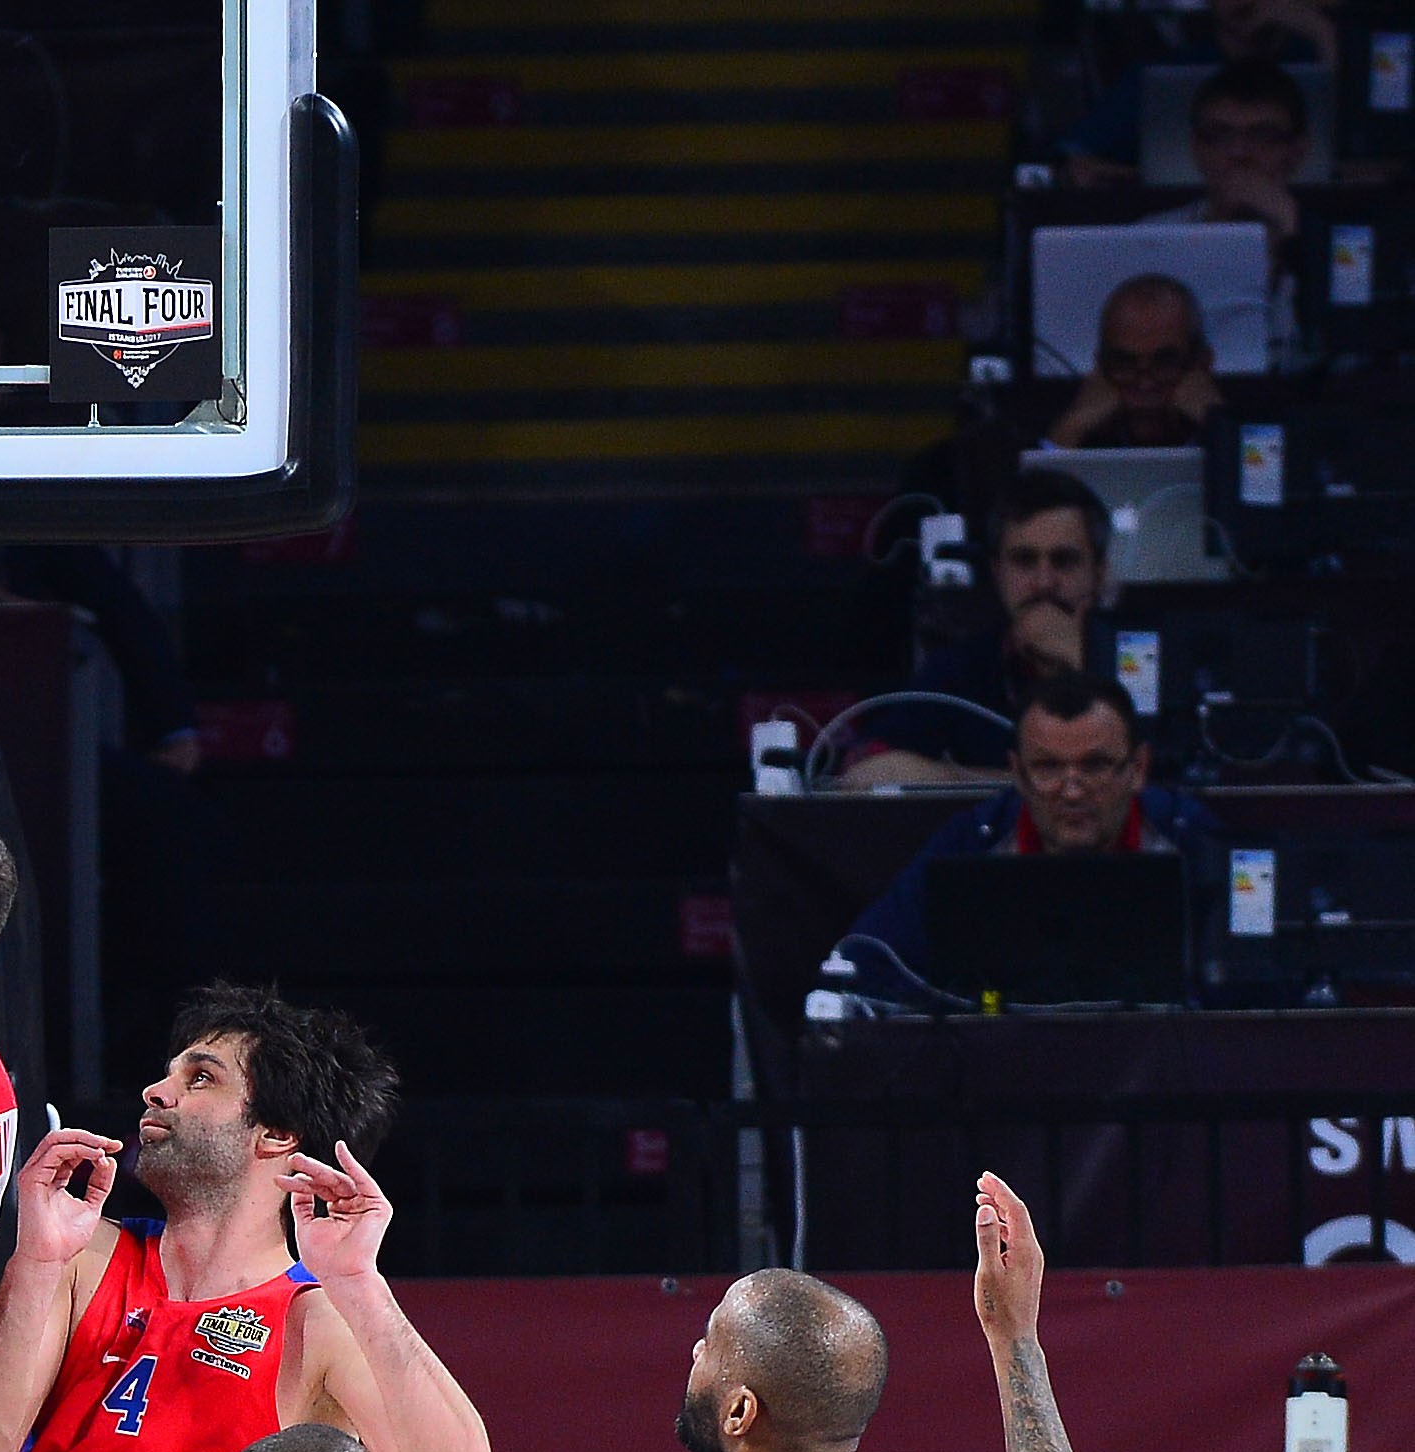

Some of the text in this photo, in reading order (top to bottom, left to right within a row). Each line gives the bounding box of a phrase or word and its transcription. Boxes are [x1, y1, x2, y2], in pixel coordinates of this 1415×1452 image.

[65, 287, 205, 325] FINAL FOUR
[234, 1324, 264, 1342] FOUR
[102, 1355, 158, 1436] 4
